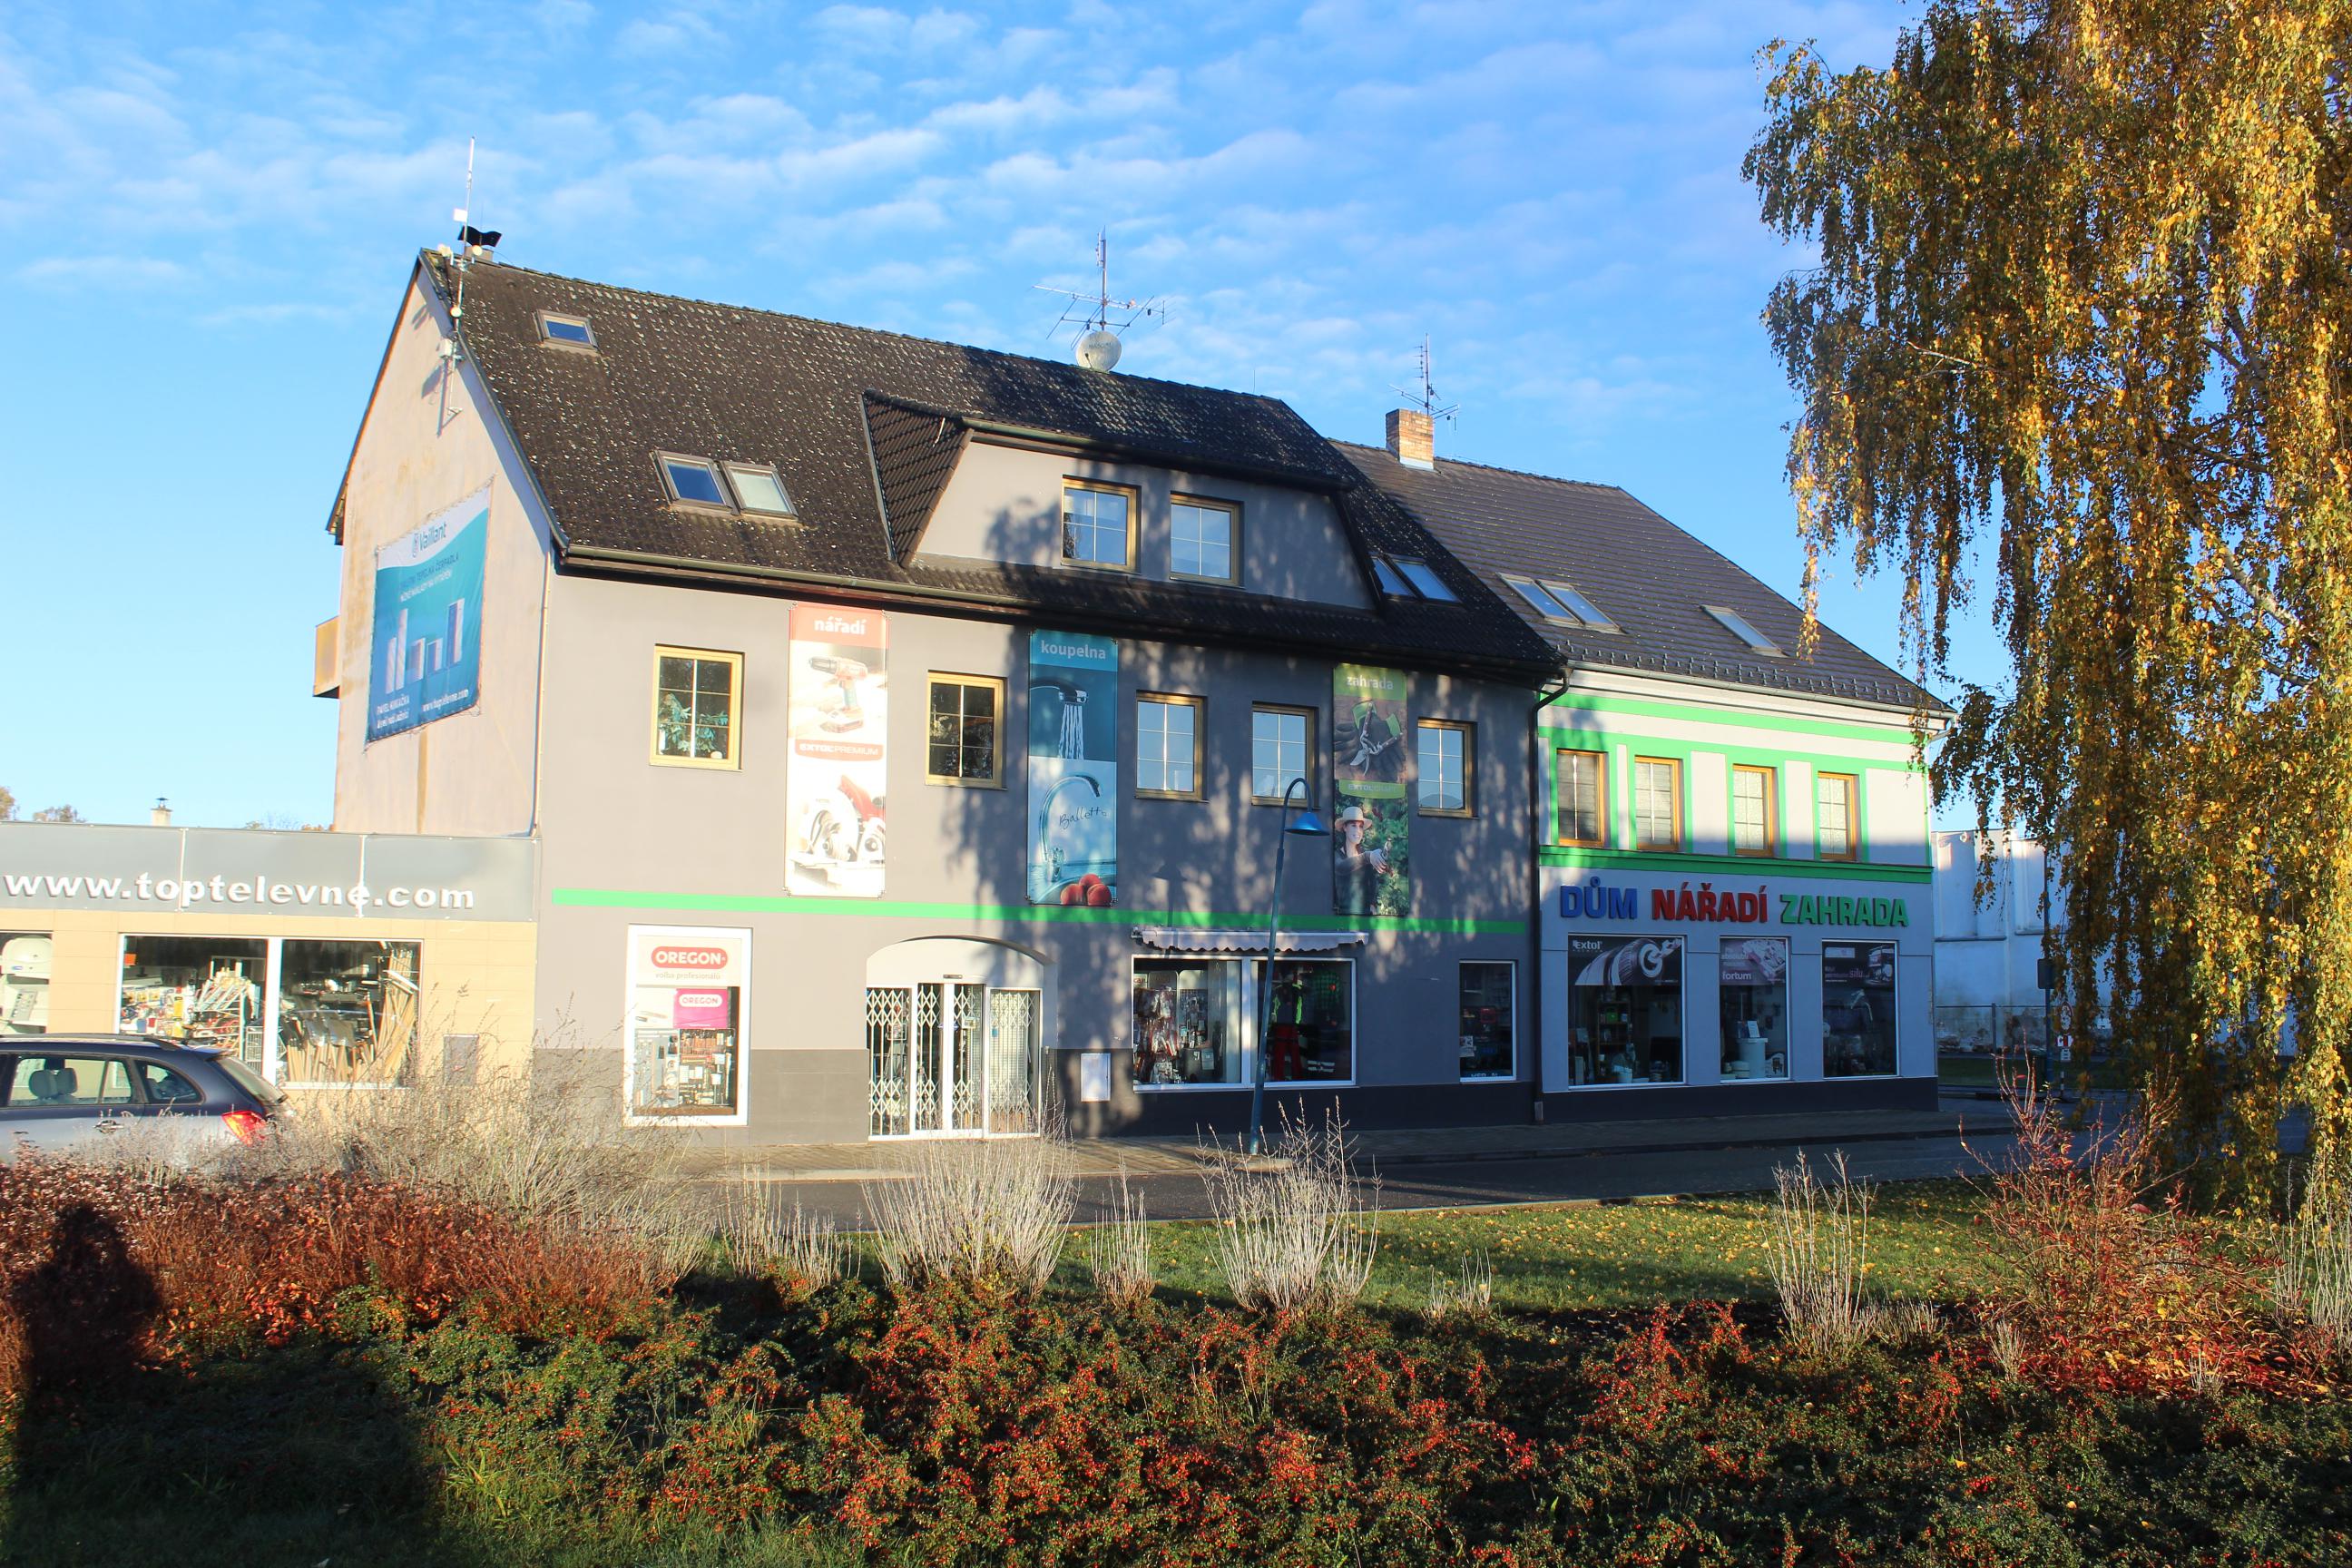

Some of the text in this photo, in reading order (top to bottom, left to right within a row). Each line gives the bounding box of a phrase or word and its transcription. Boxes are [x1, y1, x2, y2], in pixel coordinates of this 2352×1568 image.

[420, 521, 447, 551] Vaillant
[814, 616, 867, 635] nářadí
[1041, 640, 1106, 660] koupelna
[1347, 675, 1394, 691] zahrada
[4, 872, 474, 909] www.toptelevne.com
[1560, 877, 1910, 926] DŮM NÁŘADÍ ZAHRADA
[655, 950, 721, 965] OREGON
[1722, 971, 1752, 980] fortum
[681, 996, 719, 1004] OREGON
